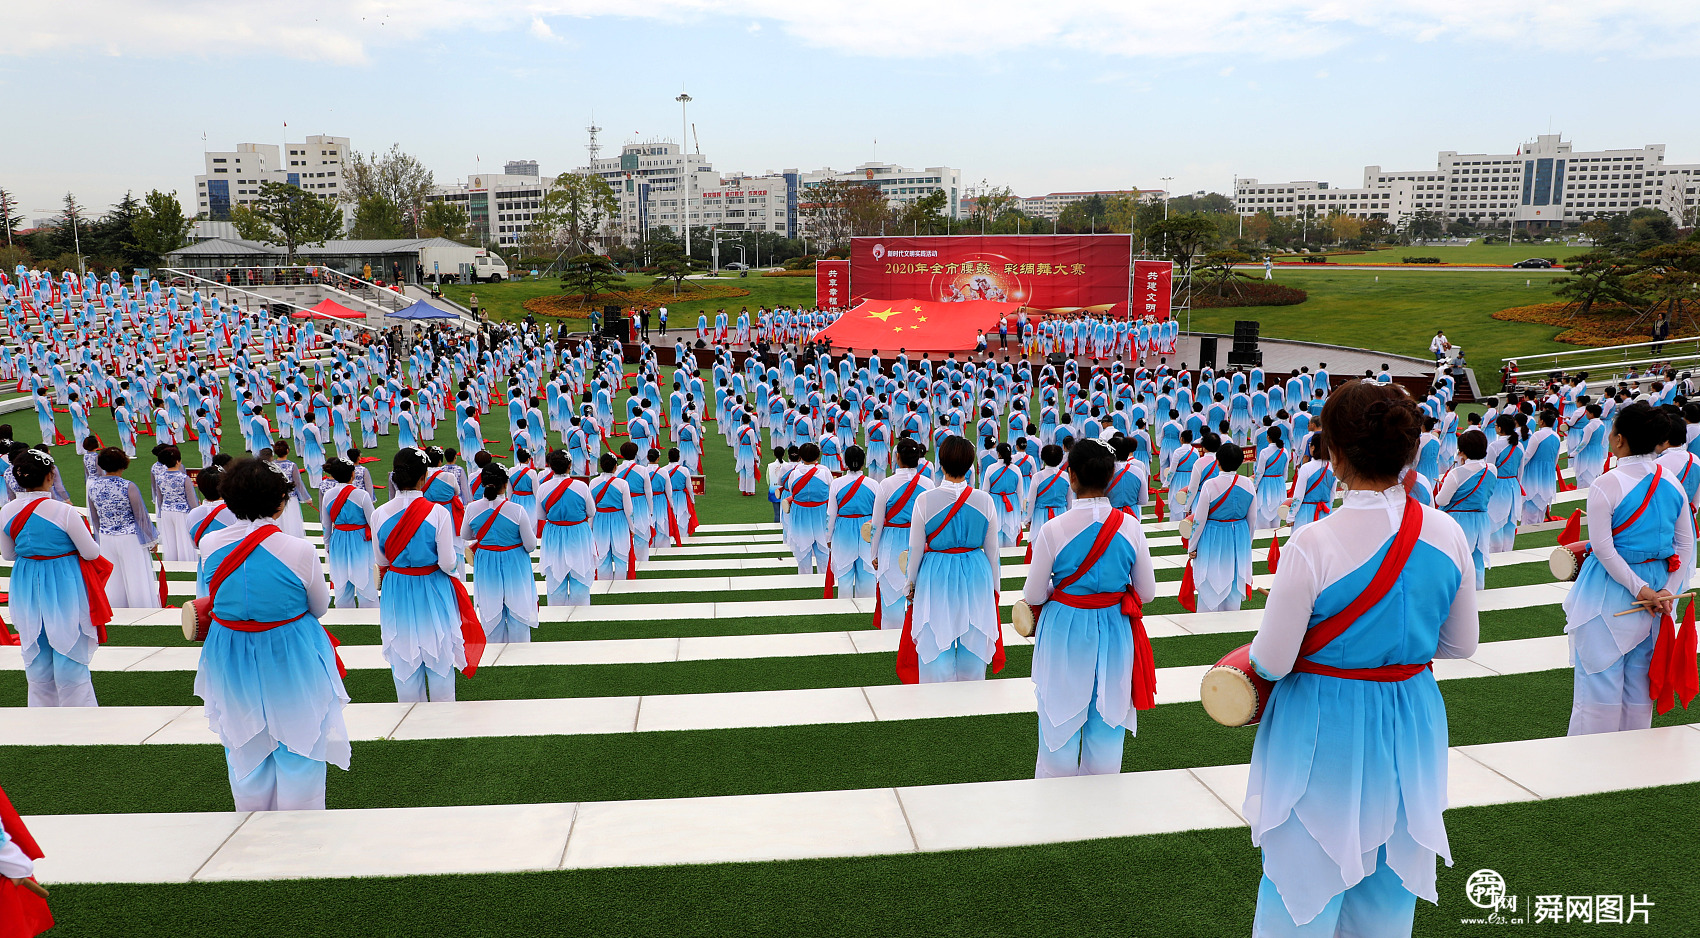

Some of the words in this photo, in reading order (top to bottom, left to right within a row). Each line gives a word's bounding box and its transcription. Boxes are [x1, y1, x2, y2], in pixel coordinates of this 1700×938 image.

[887, 250, 938, 258] 新时代文明实践活动
[885, 262, 1086, 276] 2020年全市腰鼓、彩绸舞大赛
